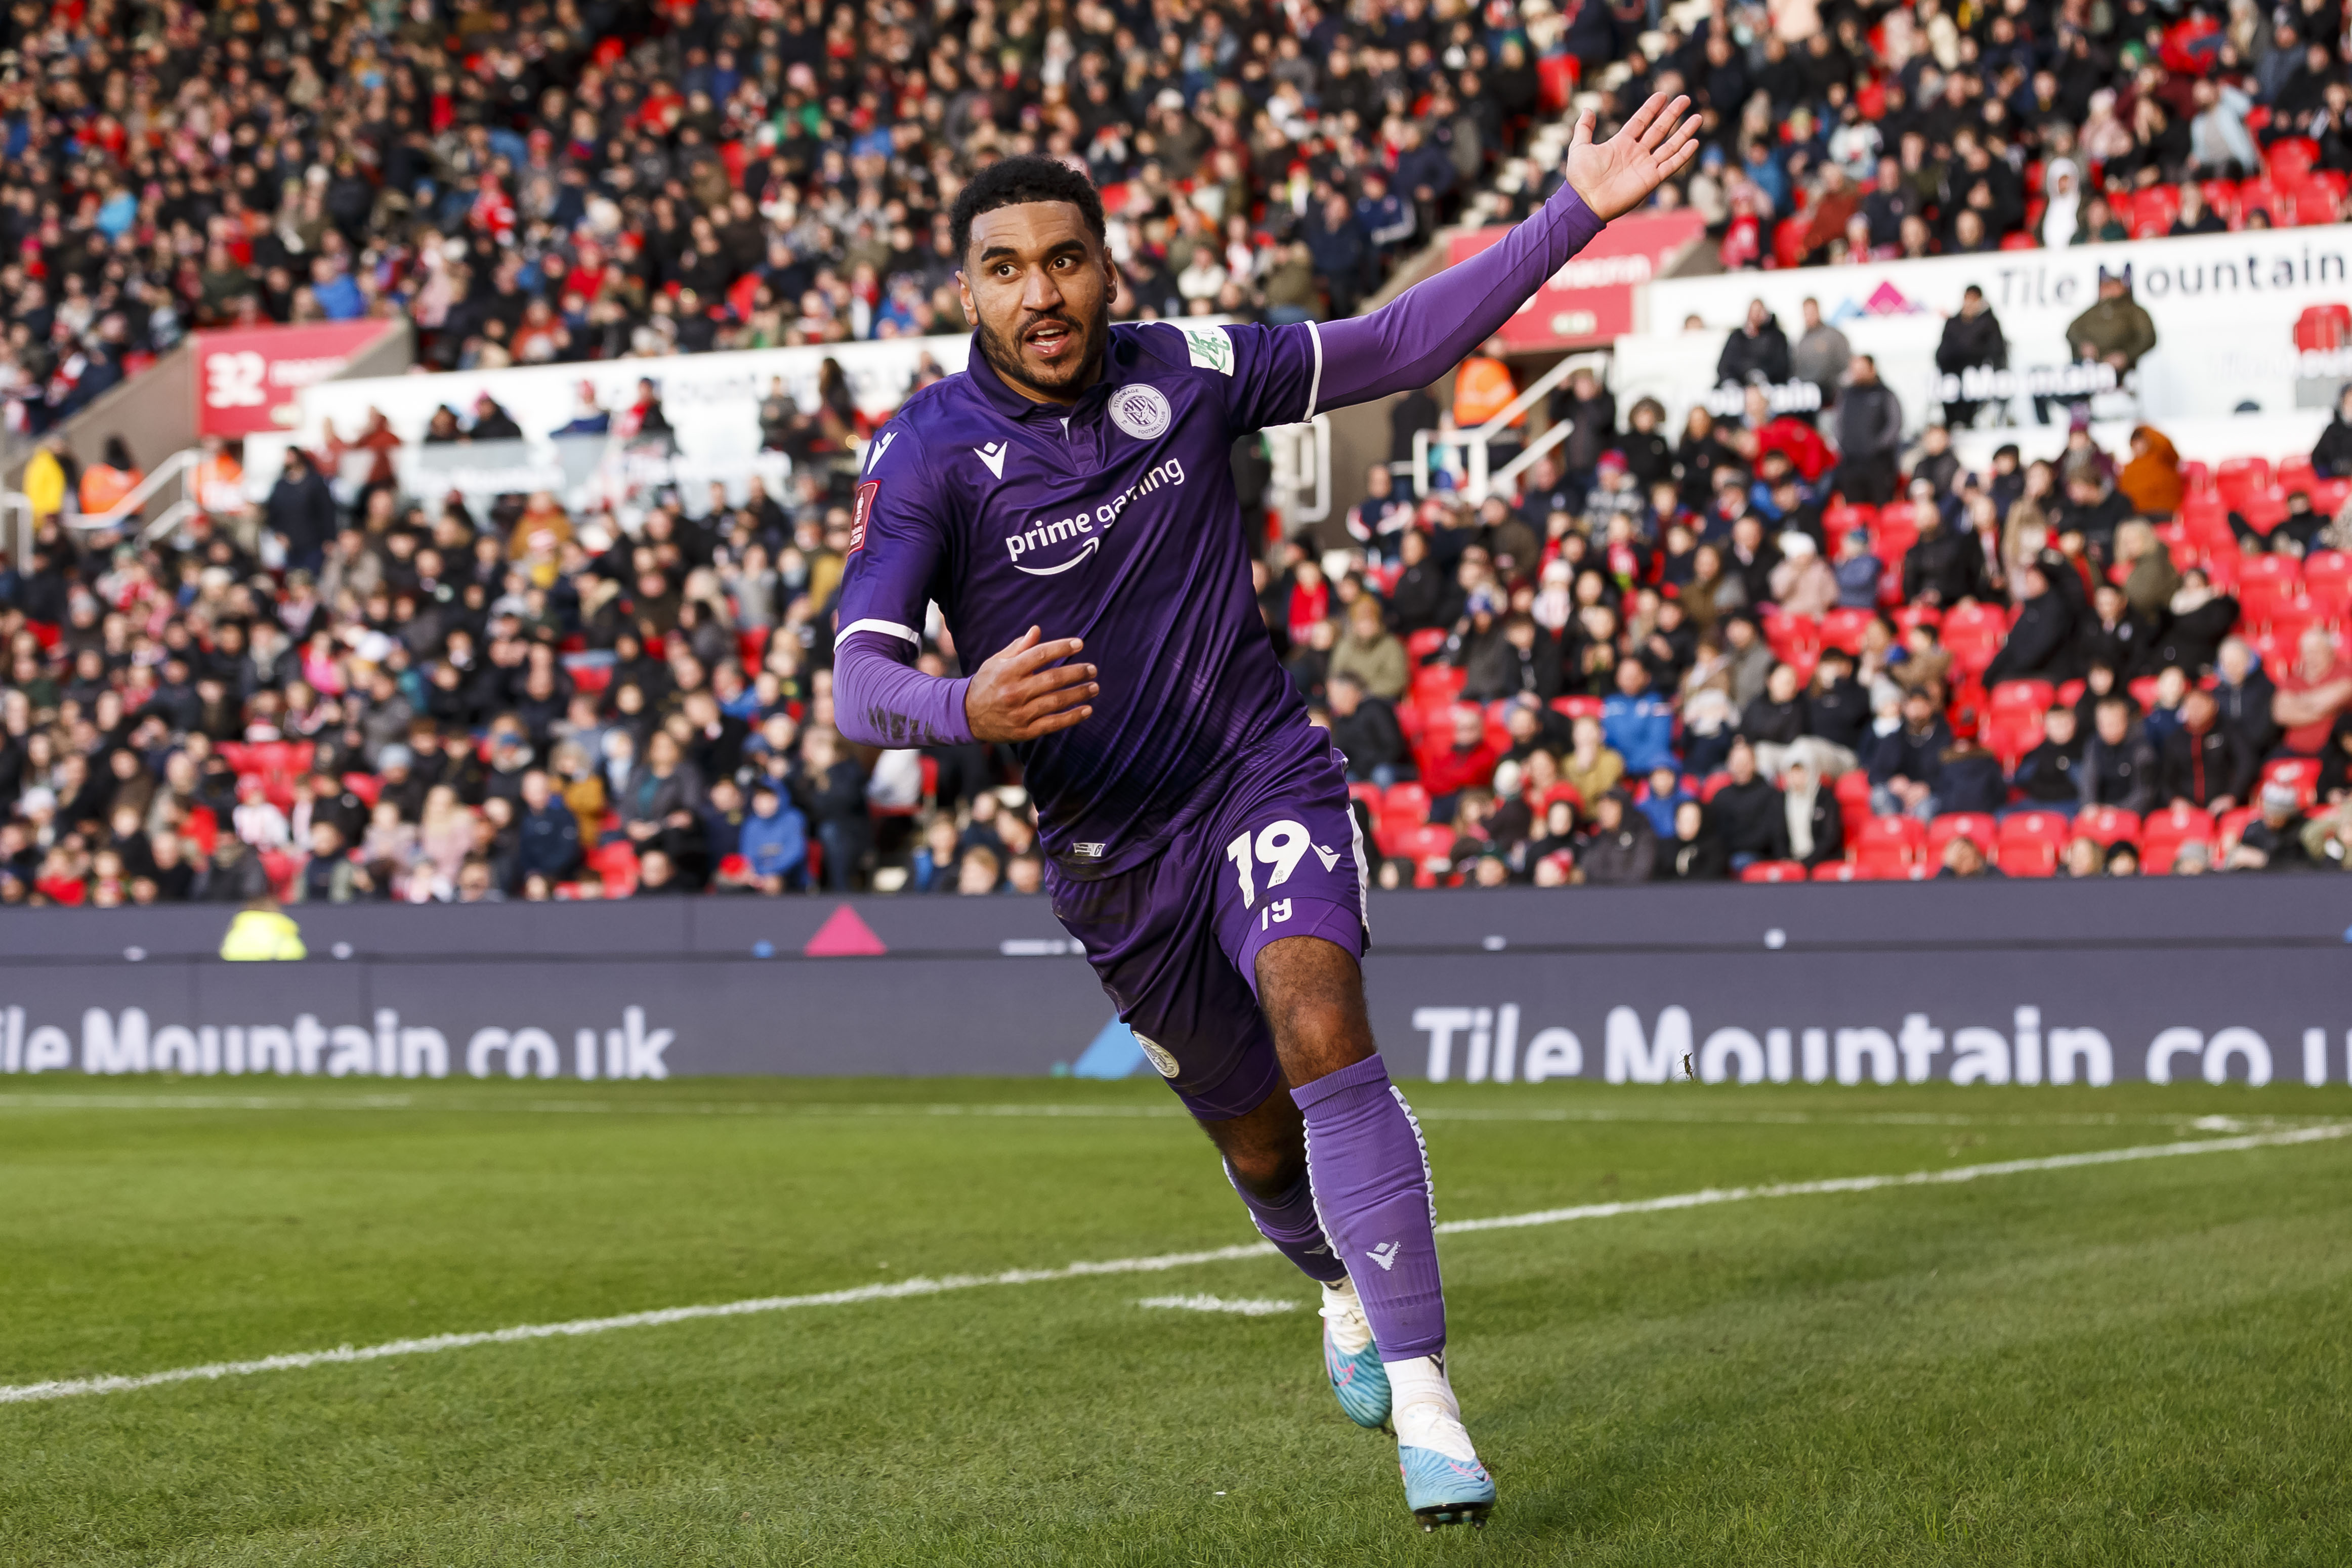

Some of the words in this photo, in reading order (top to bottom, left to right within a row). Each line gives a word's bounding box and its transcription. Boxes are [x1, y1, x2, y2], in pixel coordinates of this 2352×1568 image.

[1998, 267, 2078, 307] Tile
[1114, 389, 1139, 408] STEVENAGE
[1138, 423, 1161, 434] FOOTBALL
[1005, 513, 1093, 562] prime
[1096, 457, 1185, 528] gaming
[1227, 820, 1311, 910] 19
[1262, 898, 1292, 931] 19
[0, 1004, 72, 1074] le
[81, 1006, 449, 1079] Mountain
[1412, 1002, 1583, 1083] Tile
[1604, 1004, 2114, 1087] Mountain
